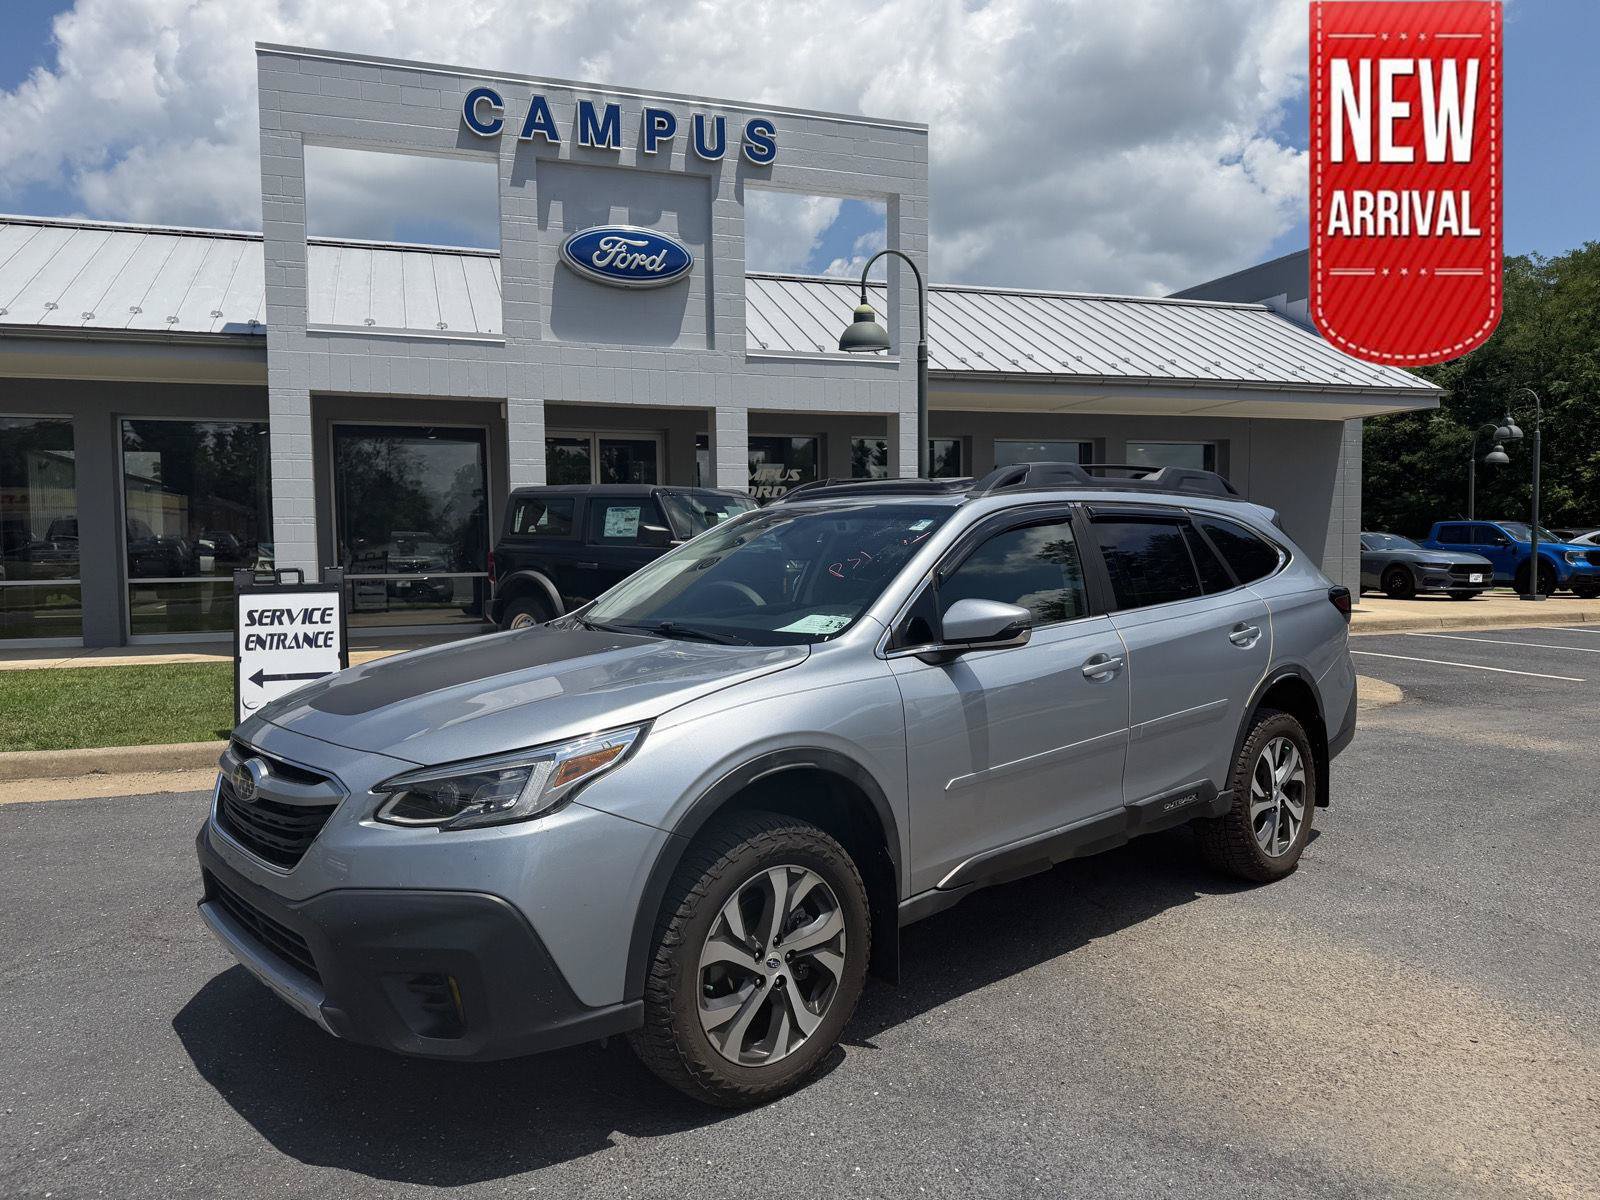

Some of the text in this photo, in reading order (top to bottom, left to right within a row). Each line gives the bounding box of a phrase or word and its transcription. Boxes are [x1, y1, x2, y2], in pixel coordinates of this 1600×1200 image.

[461, 86, 779, 166] CAMPUS
[591, 236, 668, 272] Ford
[244, 607, 334, 627] SERVICE
[244, 631, 334, 651] ENTRANCE
[1163, 793, 1199, 810] OUTBACK
